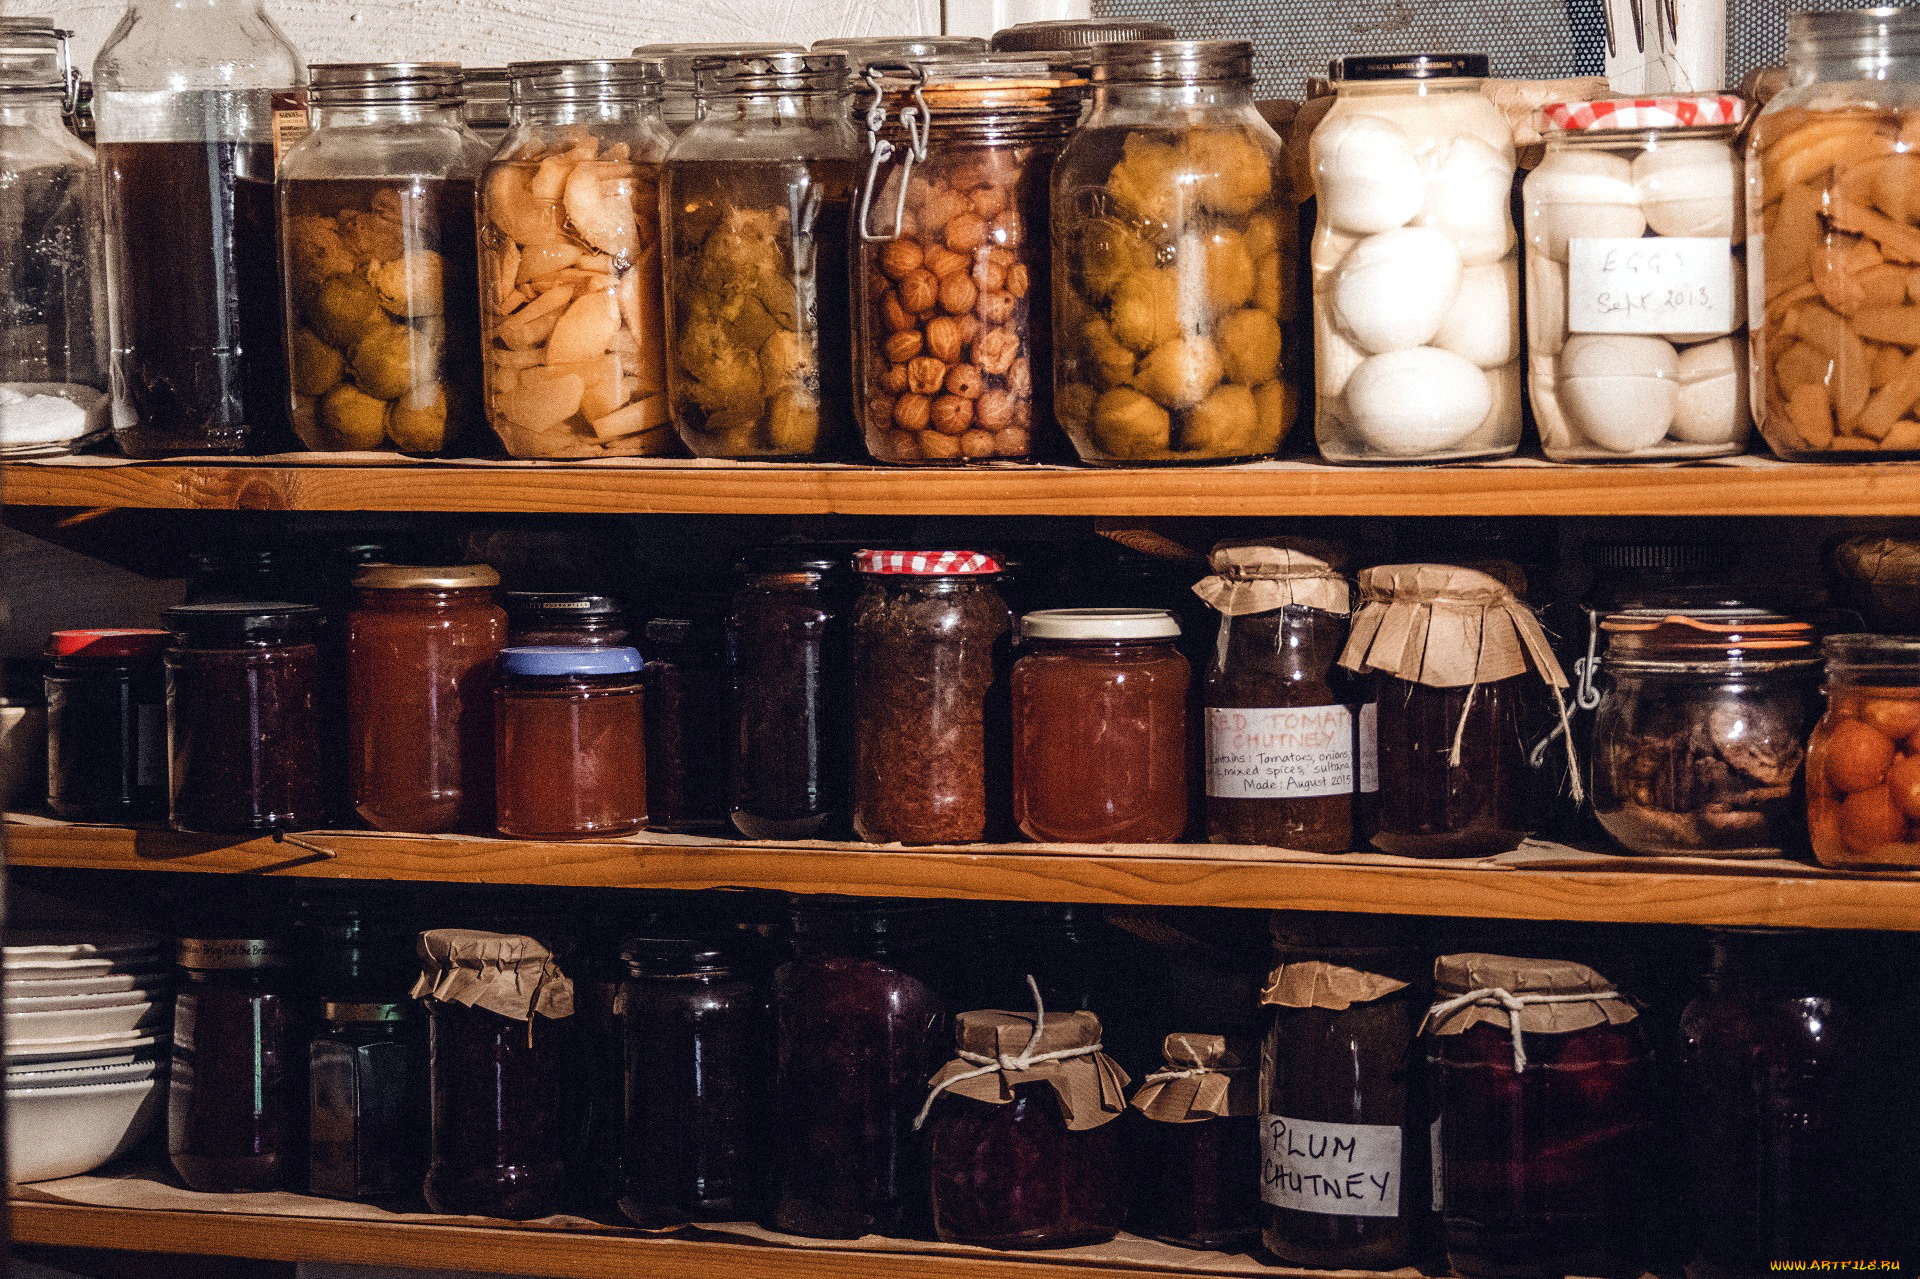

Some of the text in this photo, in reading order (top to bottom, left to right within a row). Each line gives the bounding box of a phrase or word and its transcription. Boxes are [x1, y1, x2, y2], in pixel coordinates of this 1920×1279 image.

[1268, 711, 1351, 731] TOMAT
[1232, 730, 1335, 750] CHUTNEY
[1286, 776, 1326, 791] August
[1331, 774, 1351, 786] 2015
[1270, 1119, 1356, 1163] PLUM
[1264, 1157, 1390, 1202] CHUTNEY
